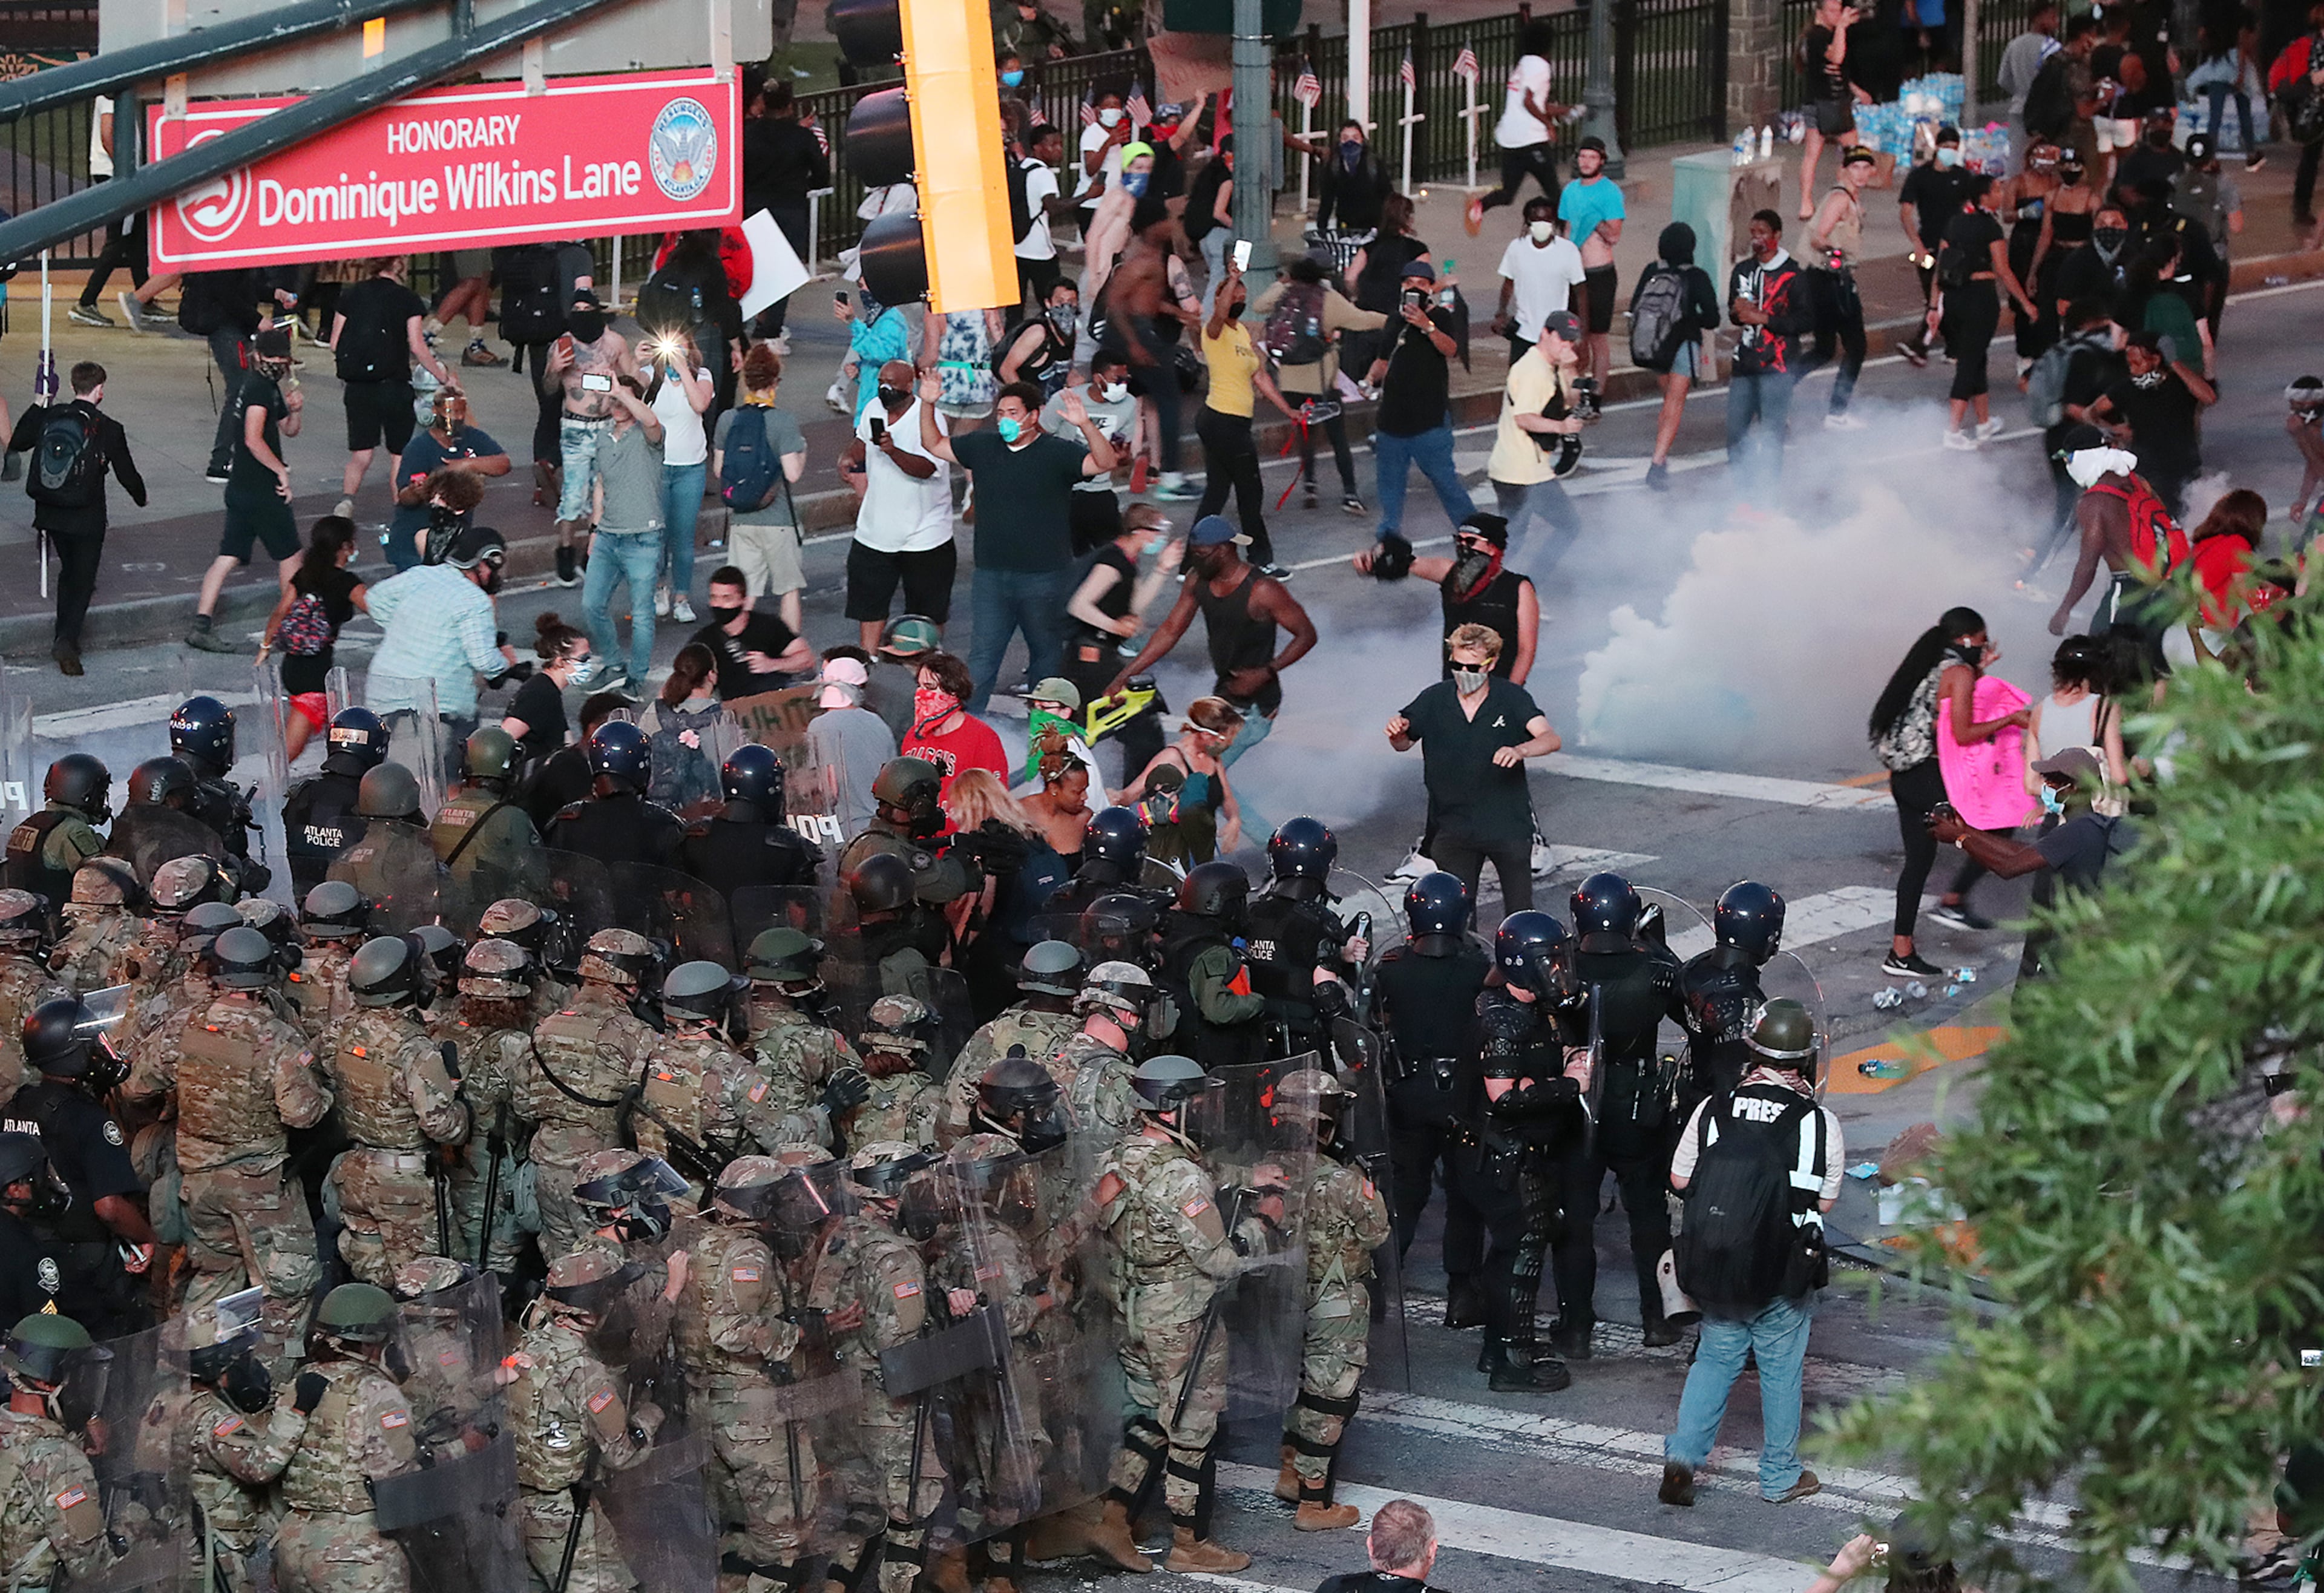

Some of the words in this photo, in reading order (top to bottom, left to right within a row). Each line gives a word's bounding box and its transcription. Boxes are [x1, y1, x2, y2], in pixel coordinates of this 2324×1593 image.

[387, 114, 520, 154] HONORARY
[258, 171, 439, 228] Dominique
[444, 159, 557, 211] Wilkins
[563, 154, 642, 200] Lane
[304, 824, 344, 839] ATLANTA
[306, 835, 340, 847] POLICE
[1732, 1096, 1790, 1124] PRES
[3, 1118, 41, 1136] ATLANTA
